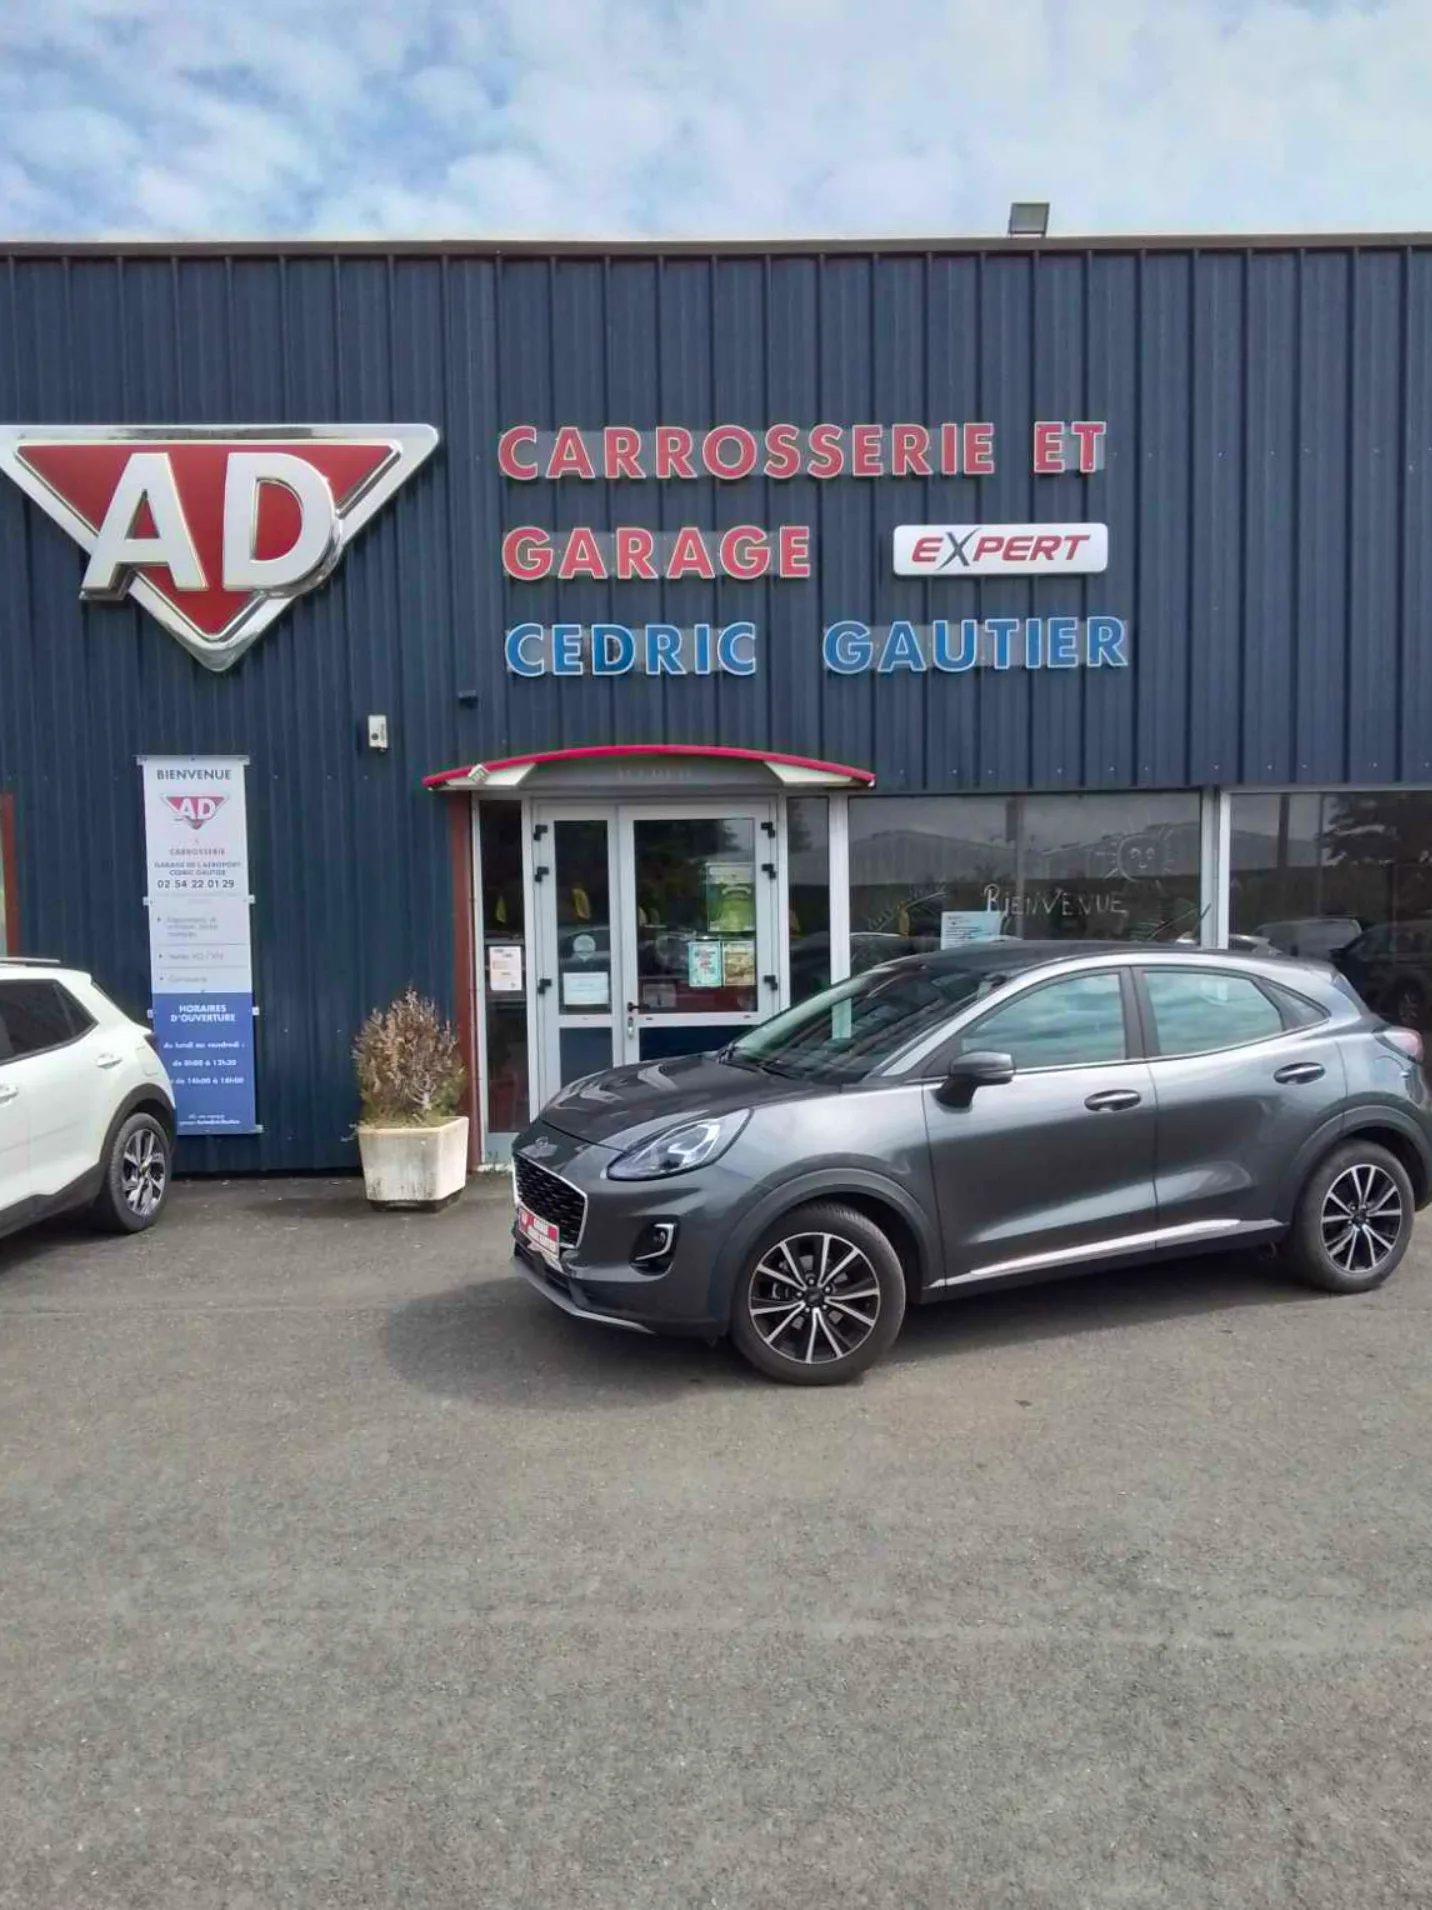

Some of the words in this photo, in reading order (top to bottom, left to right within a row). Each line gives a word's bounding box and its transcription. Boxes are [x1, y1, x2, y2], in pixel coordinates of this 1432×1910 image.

[497, 422, 995, 480] CARROSSERIE
[1034, 421, 1106, 474] ET
[81, 452, 340, 598] AD
[502, 526, 811, 581] GARAGE
[911, 527, 1091, 571] EXPERT
[505, 622, 756, 677] CEDRIC
[823, 617, 1128, 674] GAUTIER
[157, 769, 232, 780] BIENVENUE
[177, 798, 216, 821] AD
[157, 880, 170, 888] 02
[174, 880, 187, 888] 54
[191, 880, 204, 888] 22
[207, 880, 218, 888] 01
[222, 880, 234, 888] 29
[170, 1014, 236, 1022] D'OUVERTURE
[179, 1004, 227, 1013] HORAIRES
